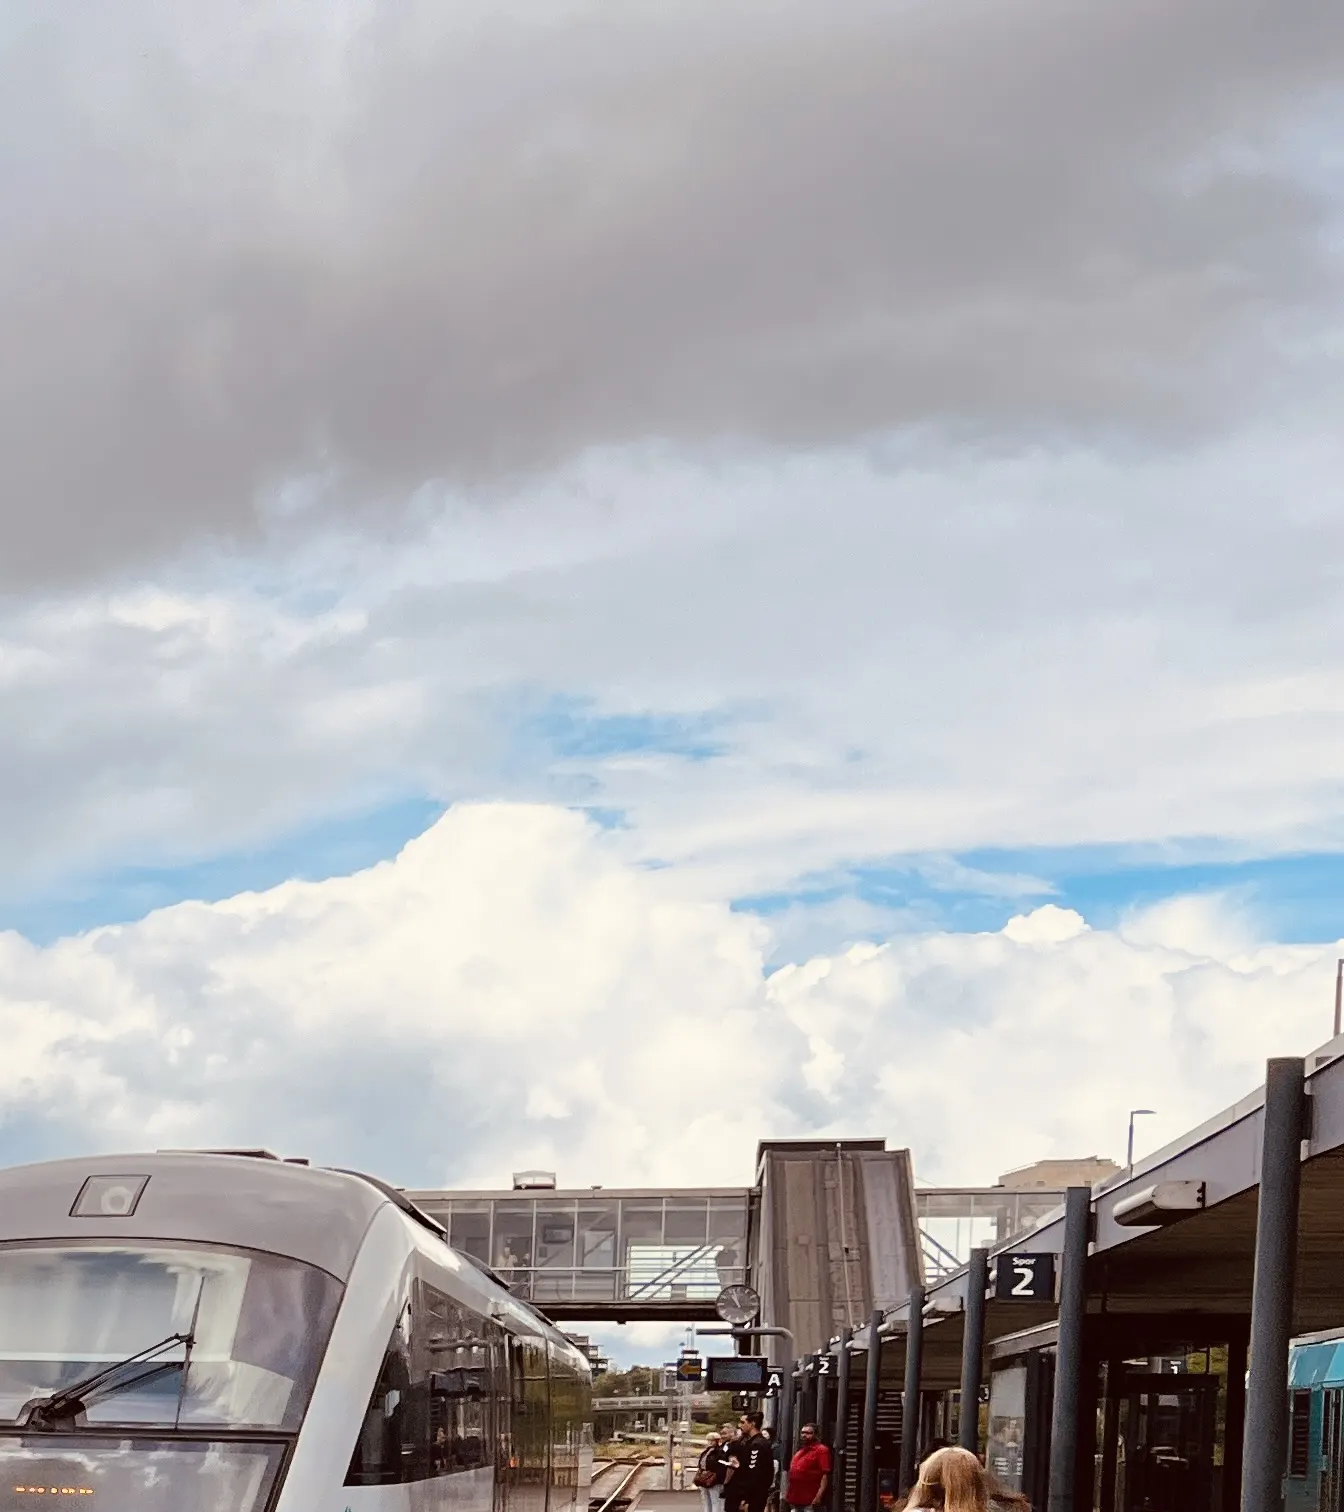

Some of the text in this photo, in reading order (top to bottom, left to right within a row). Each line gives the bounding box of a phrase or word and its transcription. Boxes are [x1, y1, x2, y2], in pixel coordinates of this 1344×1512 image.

[1011, 1268, 1034, 1295] 2
[818, 1361, 830, 1374] 2
[767, 1374, 781, 1386] A
